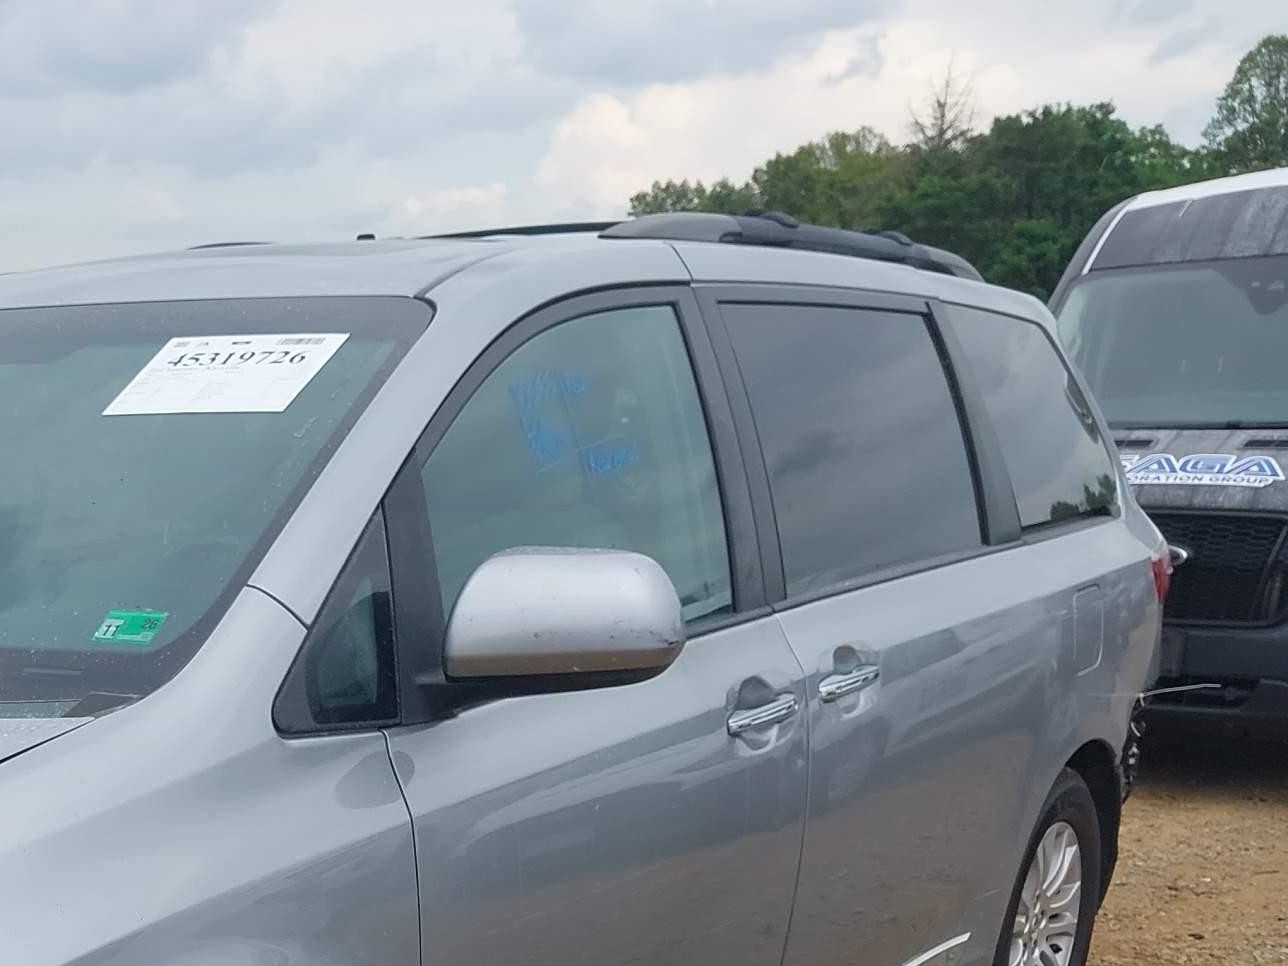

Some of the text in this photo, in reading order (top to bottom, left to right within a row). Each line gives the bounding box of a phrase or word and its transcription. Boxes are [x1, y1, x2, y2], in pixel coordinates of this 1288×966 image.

[167, 350, 310, 367] 45319726
[1209, 475, 1271, 484] GROUP
[102, 623, 121, 637] 11
